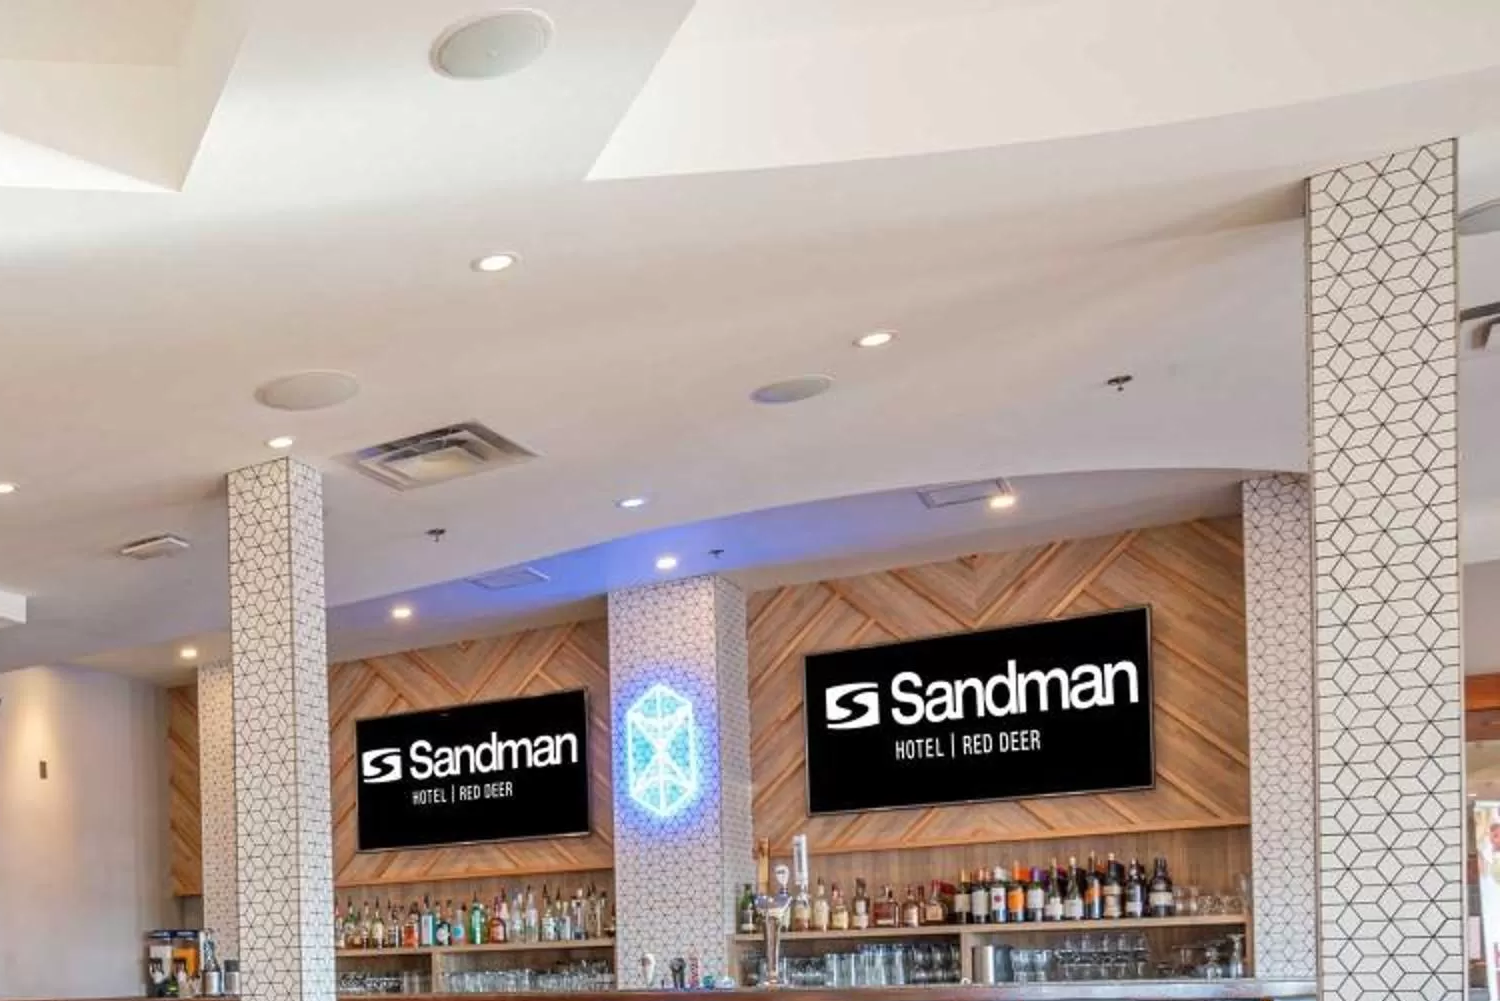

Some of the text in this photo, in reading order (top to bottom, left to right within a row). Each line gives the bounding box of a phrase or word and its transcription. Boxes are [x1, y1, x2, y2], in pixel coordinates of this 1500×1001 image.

[890, 659, 1140, 726] Sandman
[409, 731, 579, 781] Sandman
[895, 737, 945, 761] HOTEL
[962, 733, 993, 756] RED
[999, 729, 1042, 753] DEER
[412, 788, 447, 805] HOTEL
[459, 784, 481, 801] RED
[483, 781, 513, 799] DEER
